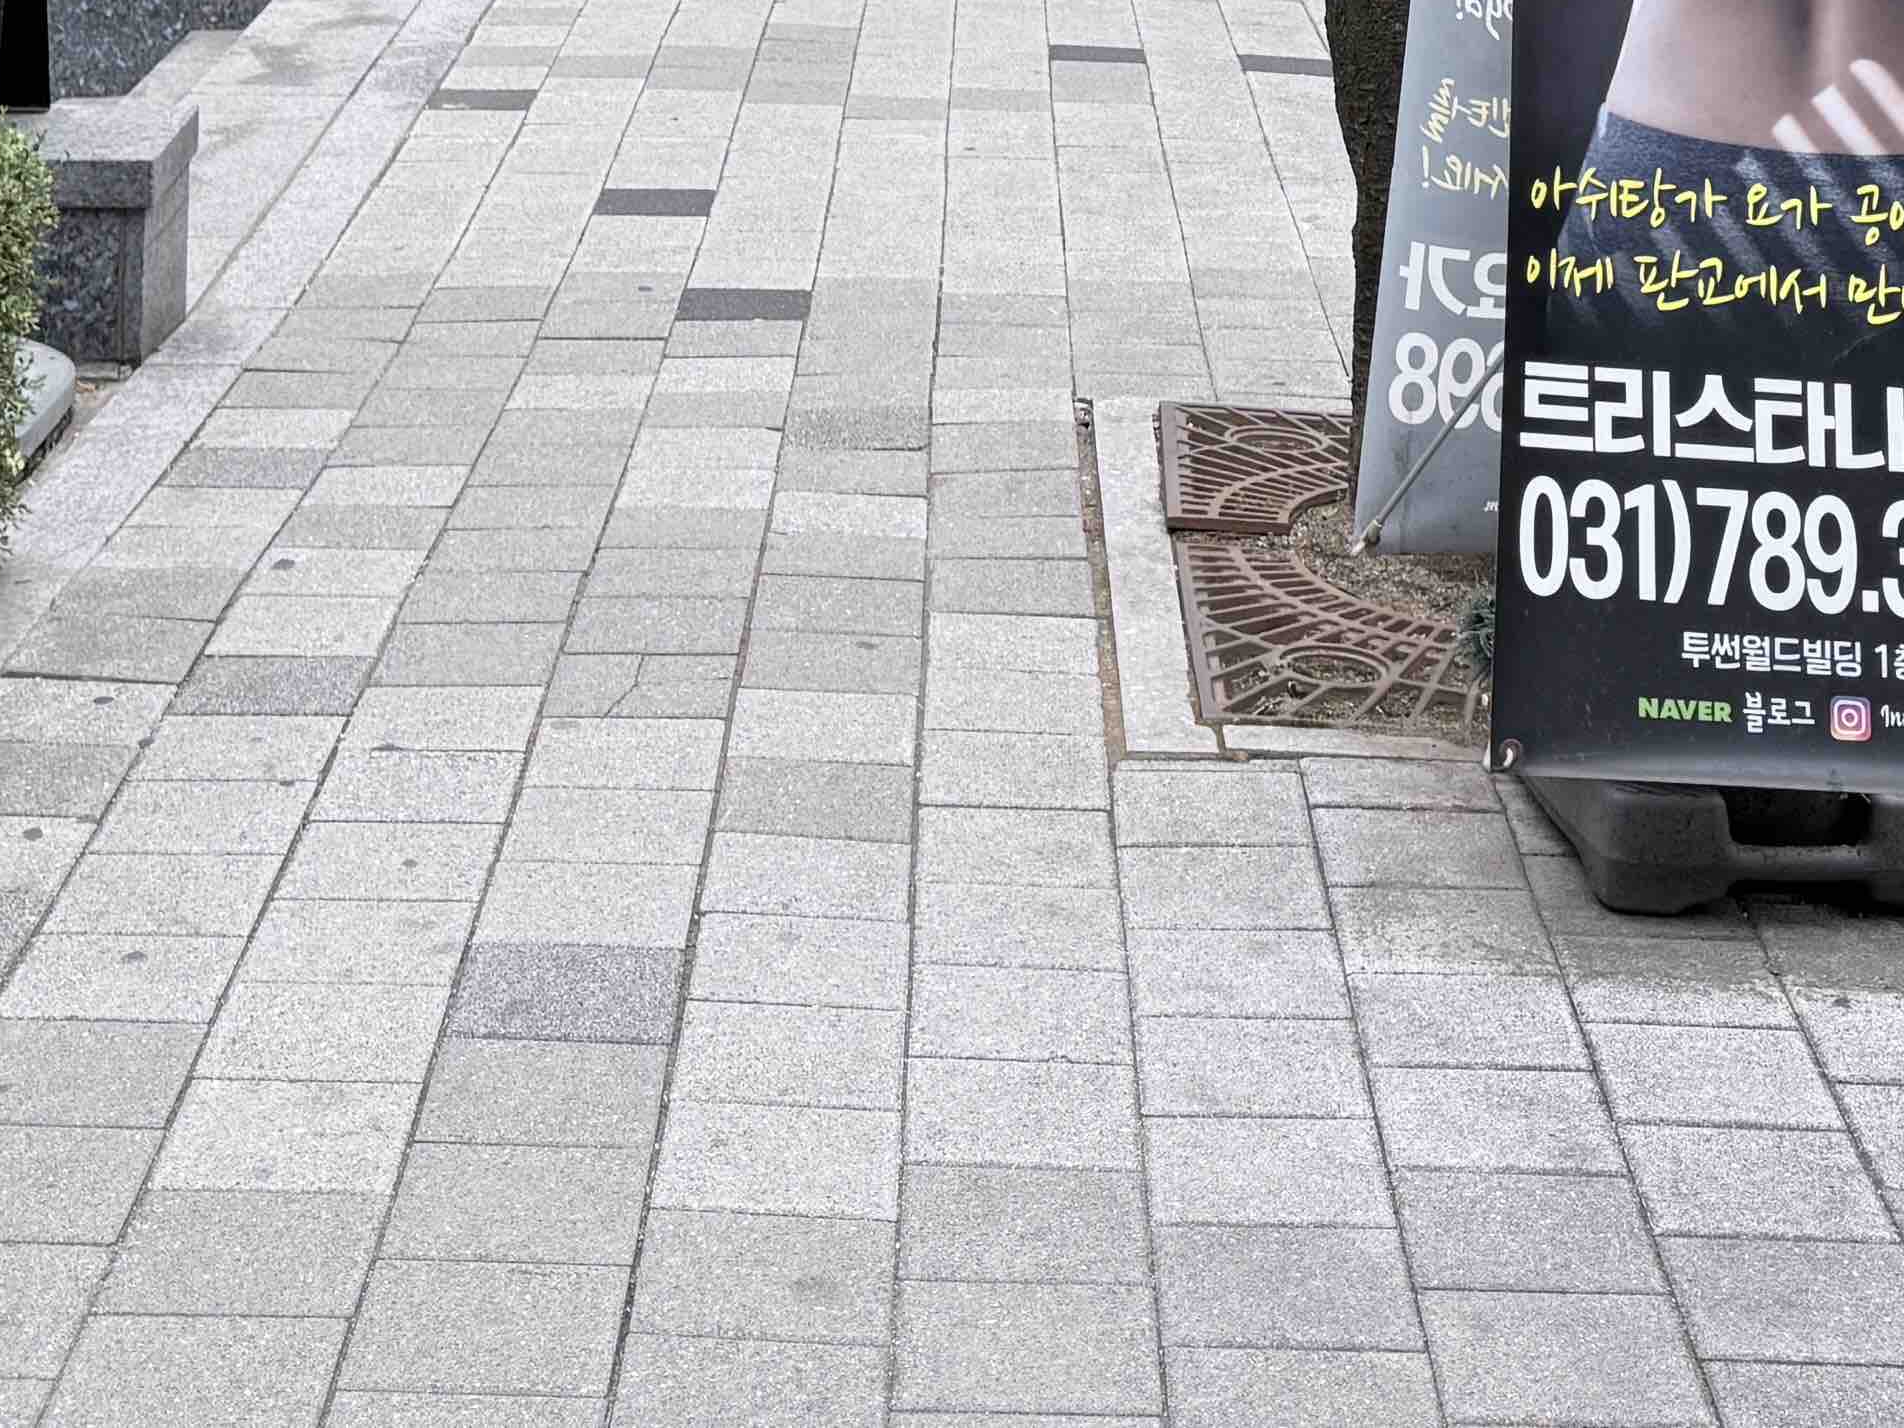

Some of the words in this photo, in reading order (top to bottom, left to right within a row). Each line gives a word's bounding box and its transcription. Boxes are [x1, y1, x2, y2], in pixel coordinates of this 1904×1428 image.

[1530, 166, 1728, 228] 아쉬탕가
[1745, 183, 1832, 231] 요가
[1526, 247, 1614, 297] 이제
[1633, 249, 1827, 315] 판교에서
[1681, 631, 1863, 678] 투썬월드빌딩
[1637, 696, 1733, 723] NAVER
[1742, 691, 1816, 734] 블로그
